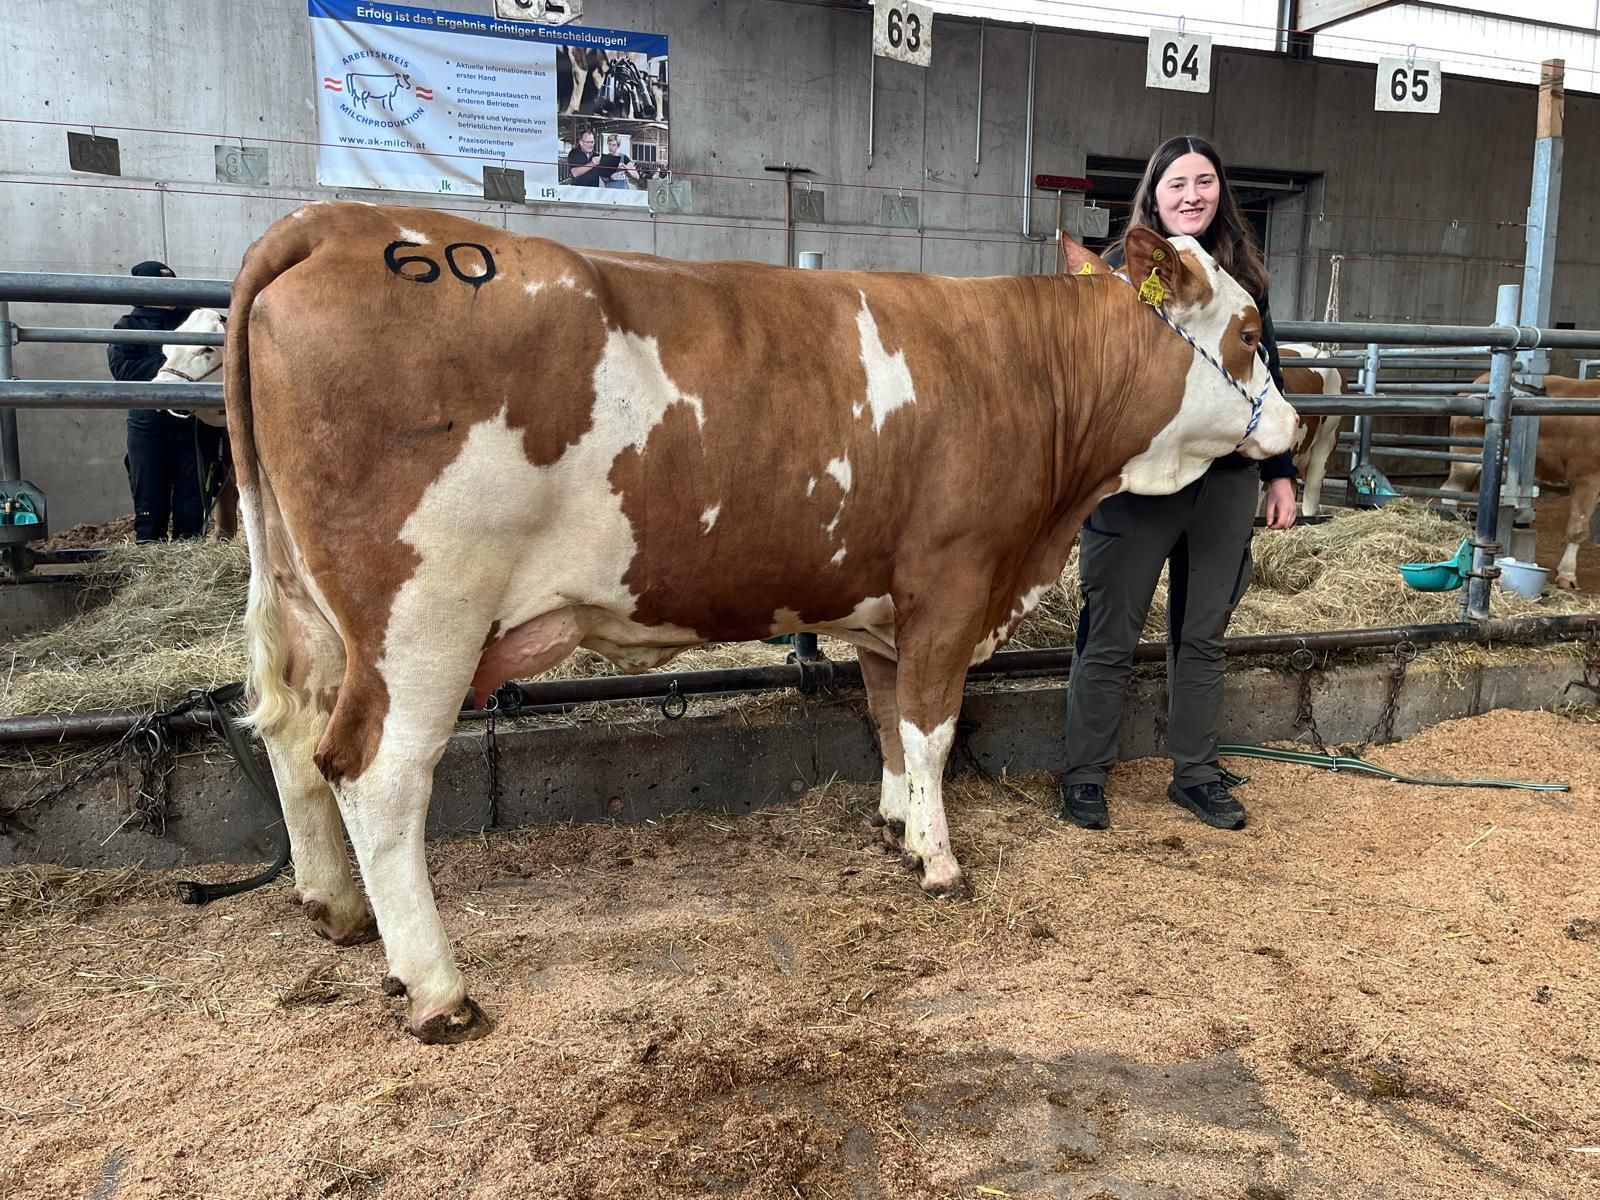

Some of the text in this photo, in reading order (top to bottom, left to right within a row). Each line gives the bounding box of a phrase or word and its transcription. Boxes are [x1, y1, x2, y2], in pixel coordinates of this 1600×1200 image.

[357, 6, 627, 47] Erfolg ist das Ergebnis richtiger Entscheidungen!
[888, 8, 920, 52] 63
[342, 50, 410, 68] ARBEITSKREIS
[1162, 42, 1198, 80] 64
[456, 62, 484, 71] Aktuelle
[485, 65, 532, 76] Informationen
[1391, 68, 1429, 102] 65
[456, 87, 529, 100] Erfahrungsaustausch
[457, 97, 519, 108] anderen Betrieben
[340, 103, 425, 128] MILCHPRODUKTION
[458, 112, 485, 121] Analyse
[501, 116, 532, 125] Vergleich
[458, 122, 542, 134] betrieblichen Kennzahlen
[339, 136, 426, 150] www.ak-milch.at
[458, 136, 514, 147] Praxisorientierte
[459, 146, 506, 157] Weiterbildung
[384, 241, 496, 288] 60
